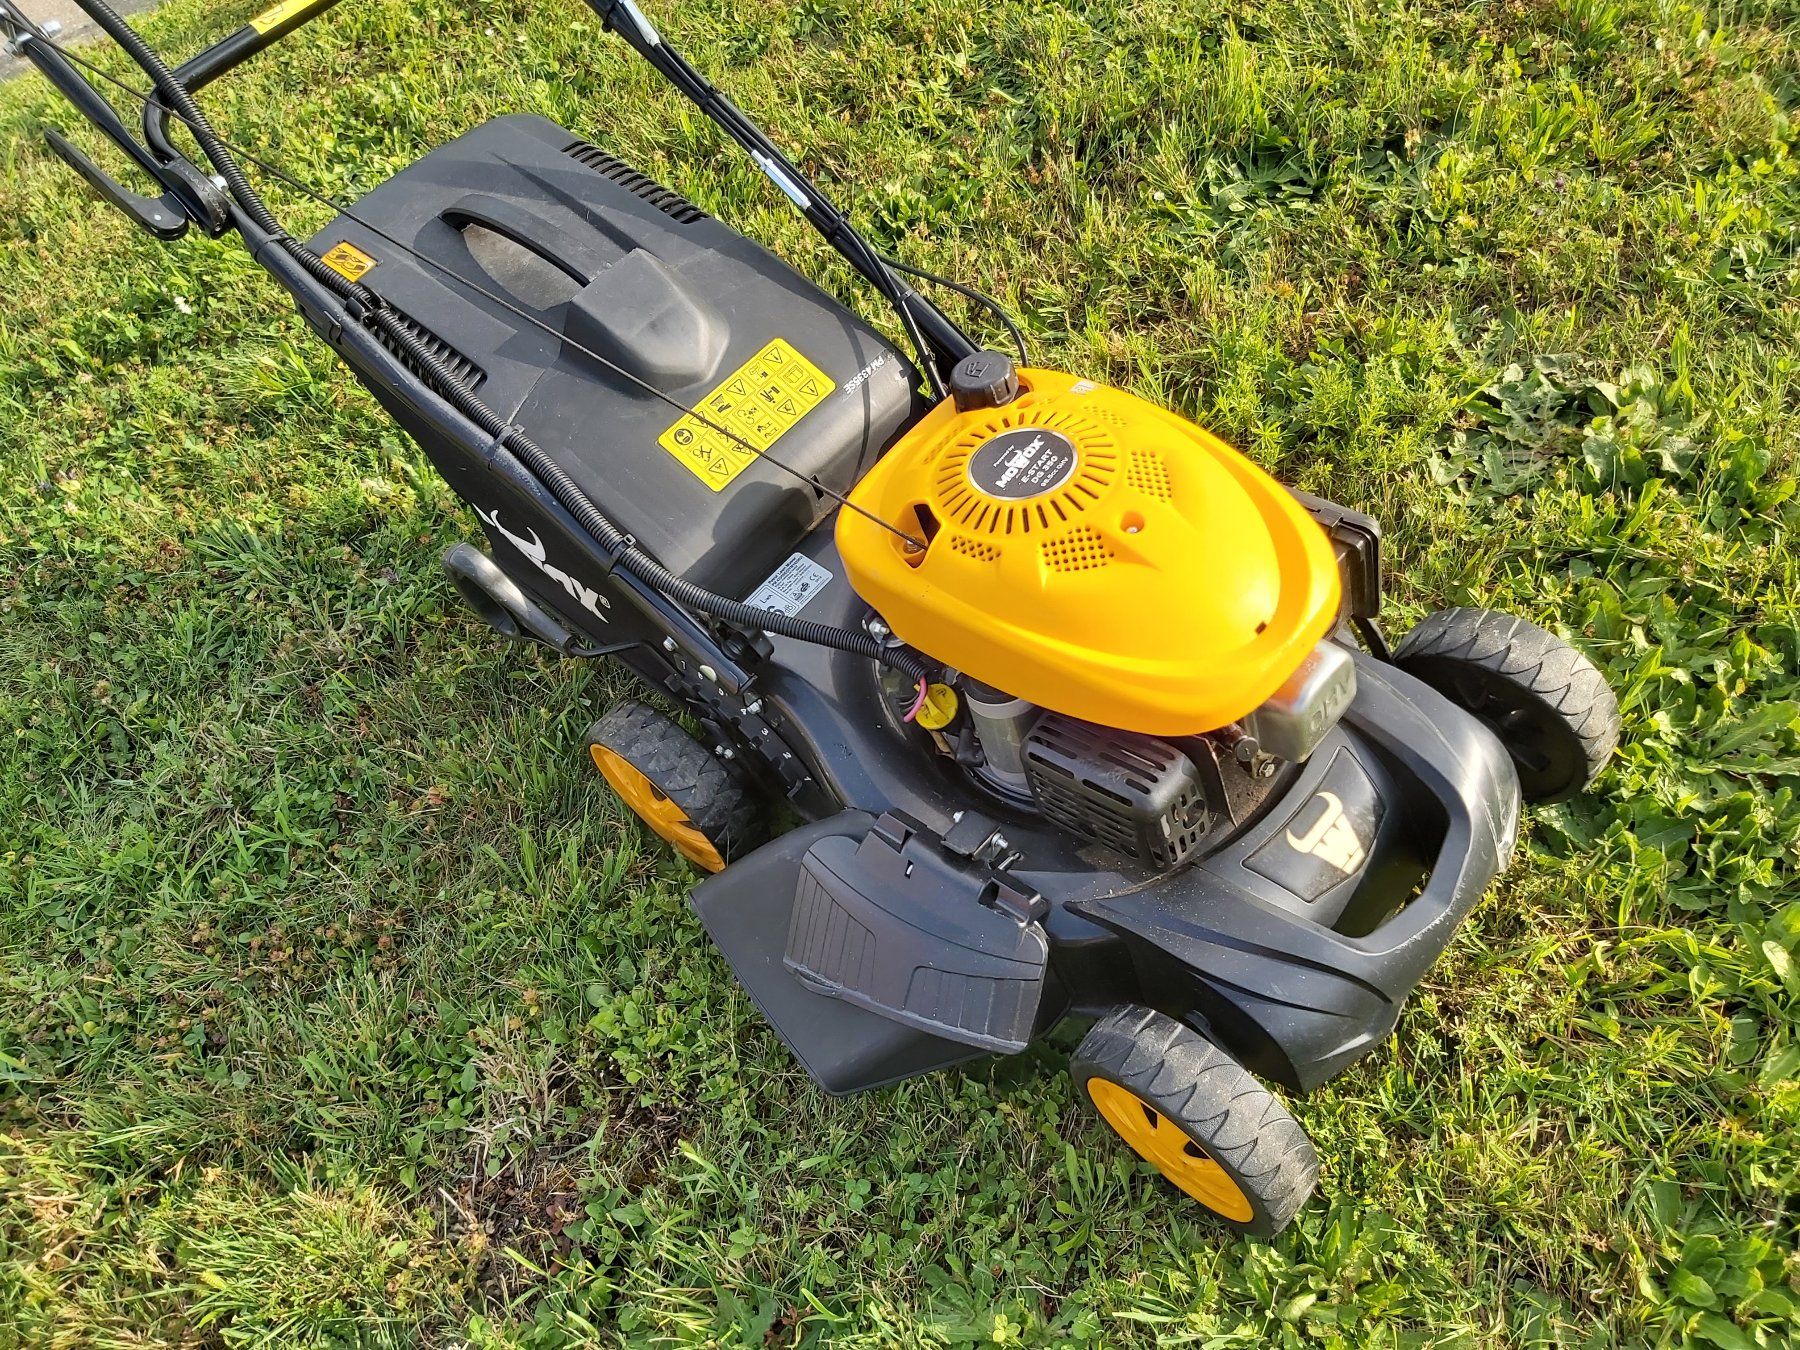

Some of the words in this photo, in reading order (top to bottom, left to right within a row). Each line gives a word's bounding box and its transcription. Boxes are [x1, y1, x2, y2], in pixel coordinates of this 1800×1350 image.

[870, 356, 885, 370] PM
[1021, 448, 1052, 483] E-START
[1031, 471, 1045, 484] DG
[1042, 455, 1058, 471] 350
[761, 727, 769, 736] 3
[782, 751, 792, 760] 2
